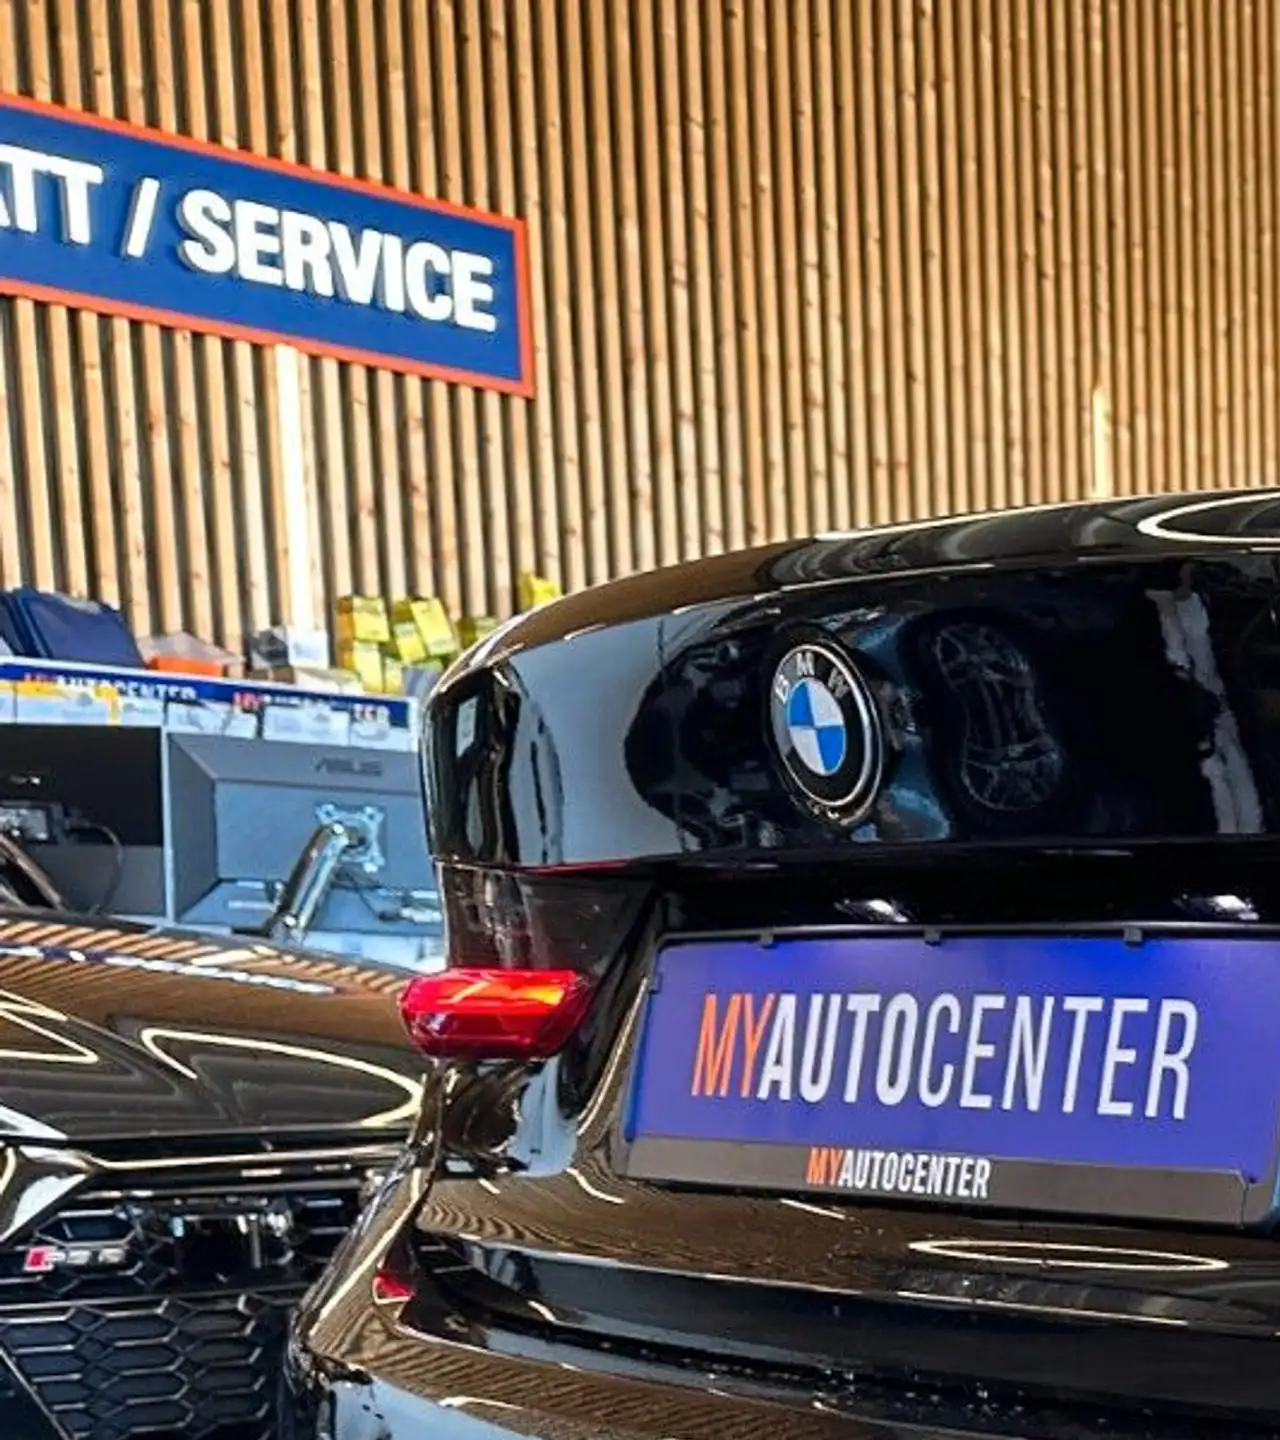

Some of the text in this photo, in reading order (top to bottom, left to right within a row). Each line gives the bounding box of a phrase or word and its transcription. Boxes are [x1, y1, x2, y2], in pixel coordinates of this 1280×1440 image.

[0, 143, 497, 332] TT / SERVICE
[774, 651, 850, 703] BMW
[690, 992, 1198, 1120] MYAUTOCENTER
[806, 1147, 991, 1198] MYAUTOCENTER
